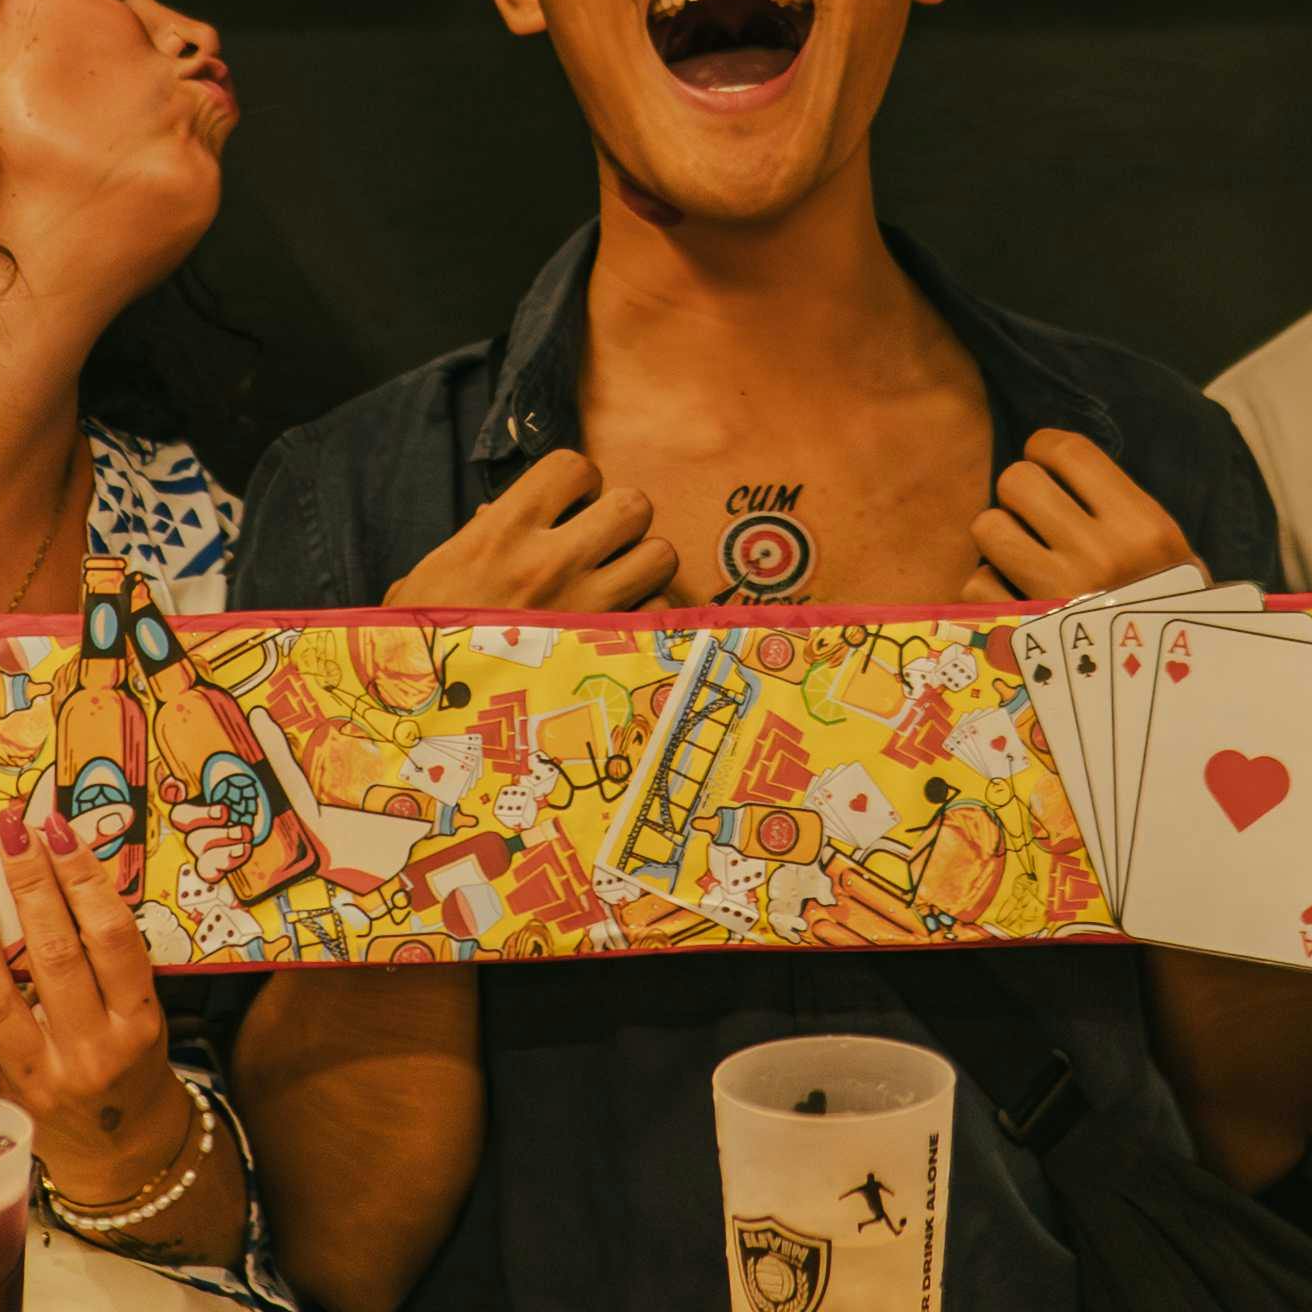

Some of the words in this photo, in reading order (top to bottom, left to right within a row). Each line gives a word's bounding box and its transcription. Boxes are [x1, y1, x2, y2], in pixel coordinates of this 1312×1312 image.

[725, 484, 805, 516] CUM
[1023, 631, 1047, 660] A
[1070, 621, 1095, 650] A
[1119, 620, 1144, 648] A
[1166, 629, 1192, 657] A
[926, 1132, 940, 1211] ALONE
[921, 1216, 935, 1291] DRINK
